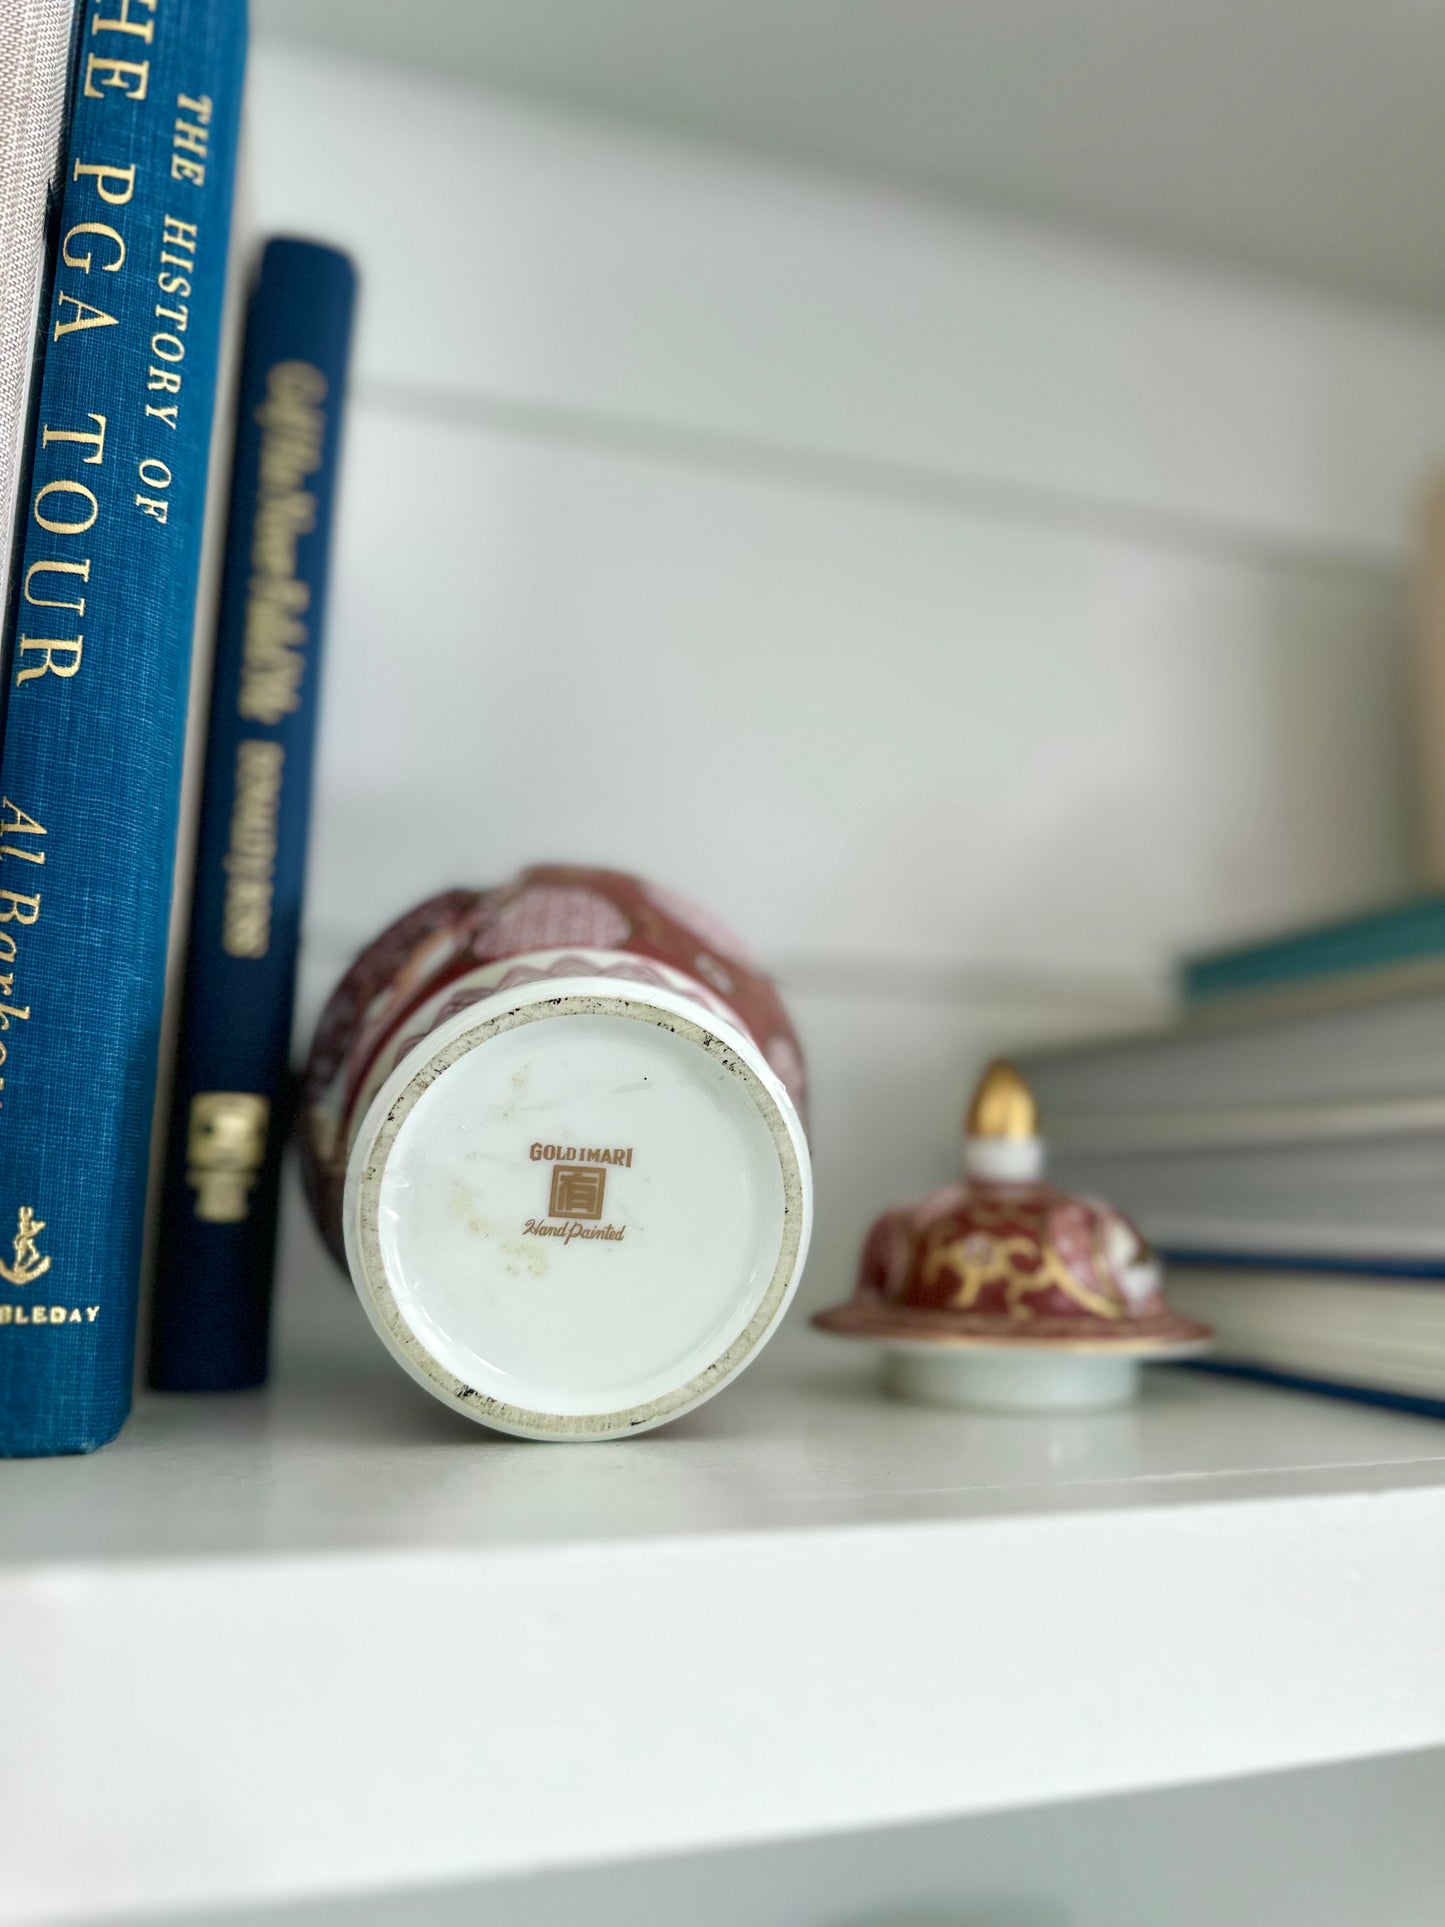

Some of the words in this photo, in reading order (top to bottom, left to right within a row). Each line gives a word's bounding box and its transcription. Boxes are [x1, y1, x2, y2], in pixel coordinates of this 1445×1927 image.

[170, 93, 213, 187] THE
[53, 157, 136, 343] PGA
[144, 213, 198, 430] HISTORY
[134, 458, 172, 524] OF
[15, 413, 107, 688] TOUR
[0, 796, 48, 866] Al
[0, 893, 41, 1108] Bark
[529, 1142, 577, 1161] GOLD
[579, 1147, 633, 1168] IMARI
[522, 1218, 569, 1238] Hand
[563, 1221, 626, 1245] Painted
